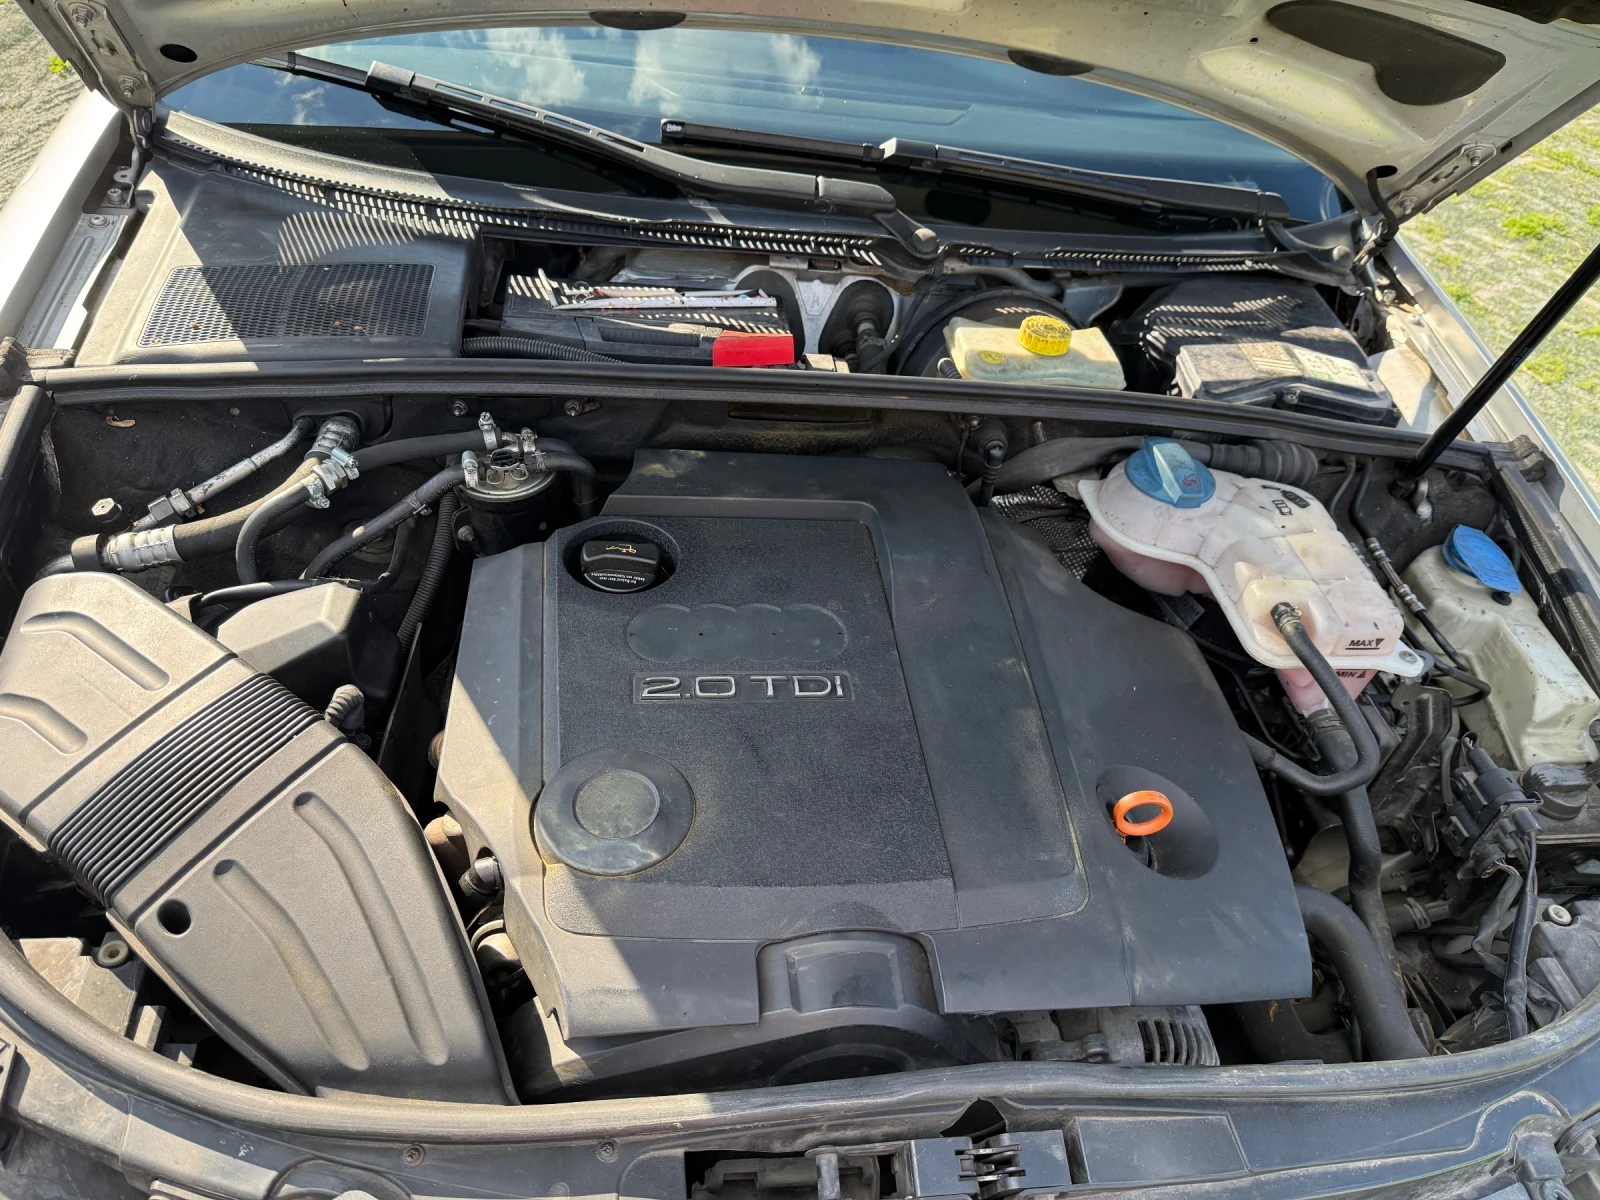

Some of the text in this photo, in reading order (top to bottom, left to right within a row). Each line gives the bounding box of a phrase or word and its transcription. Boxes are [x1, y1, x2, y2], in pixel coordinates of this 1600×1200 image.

[1348, 639, 1374, 647] MAX
[640, 675, 844, 699] 2.0 TDI
